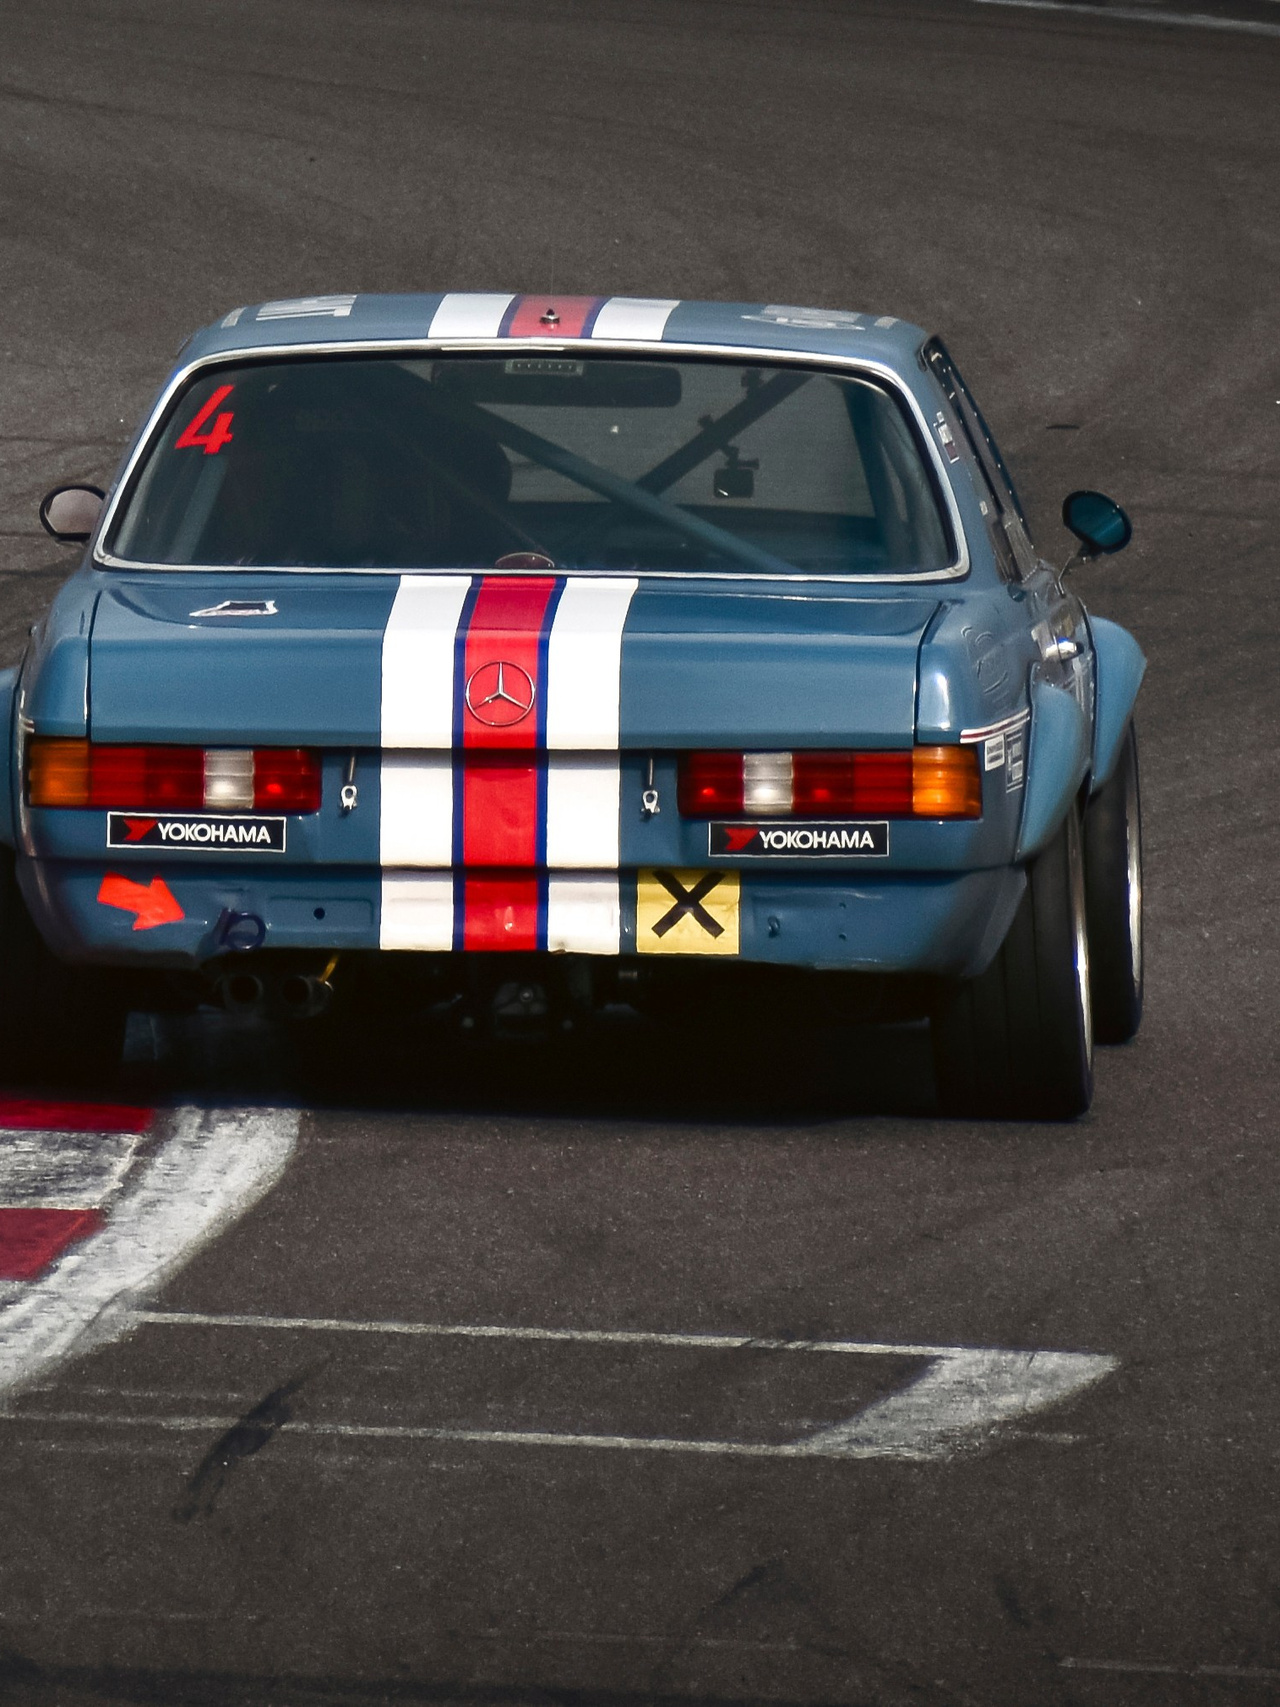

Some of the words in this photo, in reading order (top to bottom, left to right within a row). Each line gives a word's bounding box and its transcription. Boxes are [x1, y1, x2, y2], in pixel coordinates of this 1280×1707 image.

[175, 384, 235, 455] 4
[157, 822, 271, 844] YOKOHAMA
[759, 830, 875, 849] YOKOHAMA
